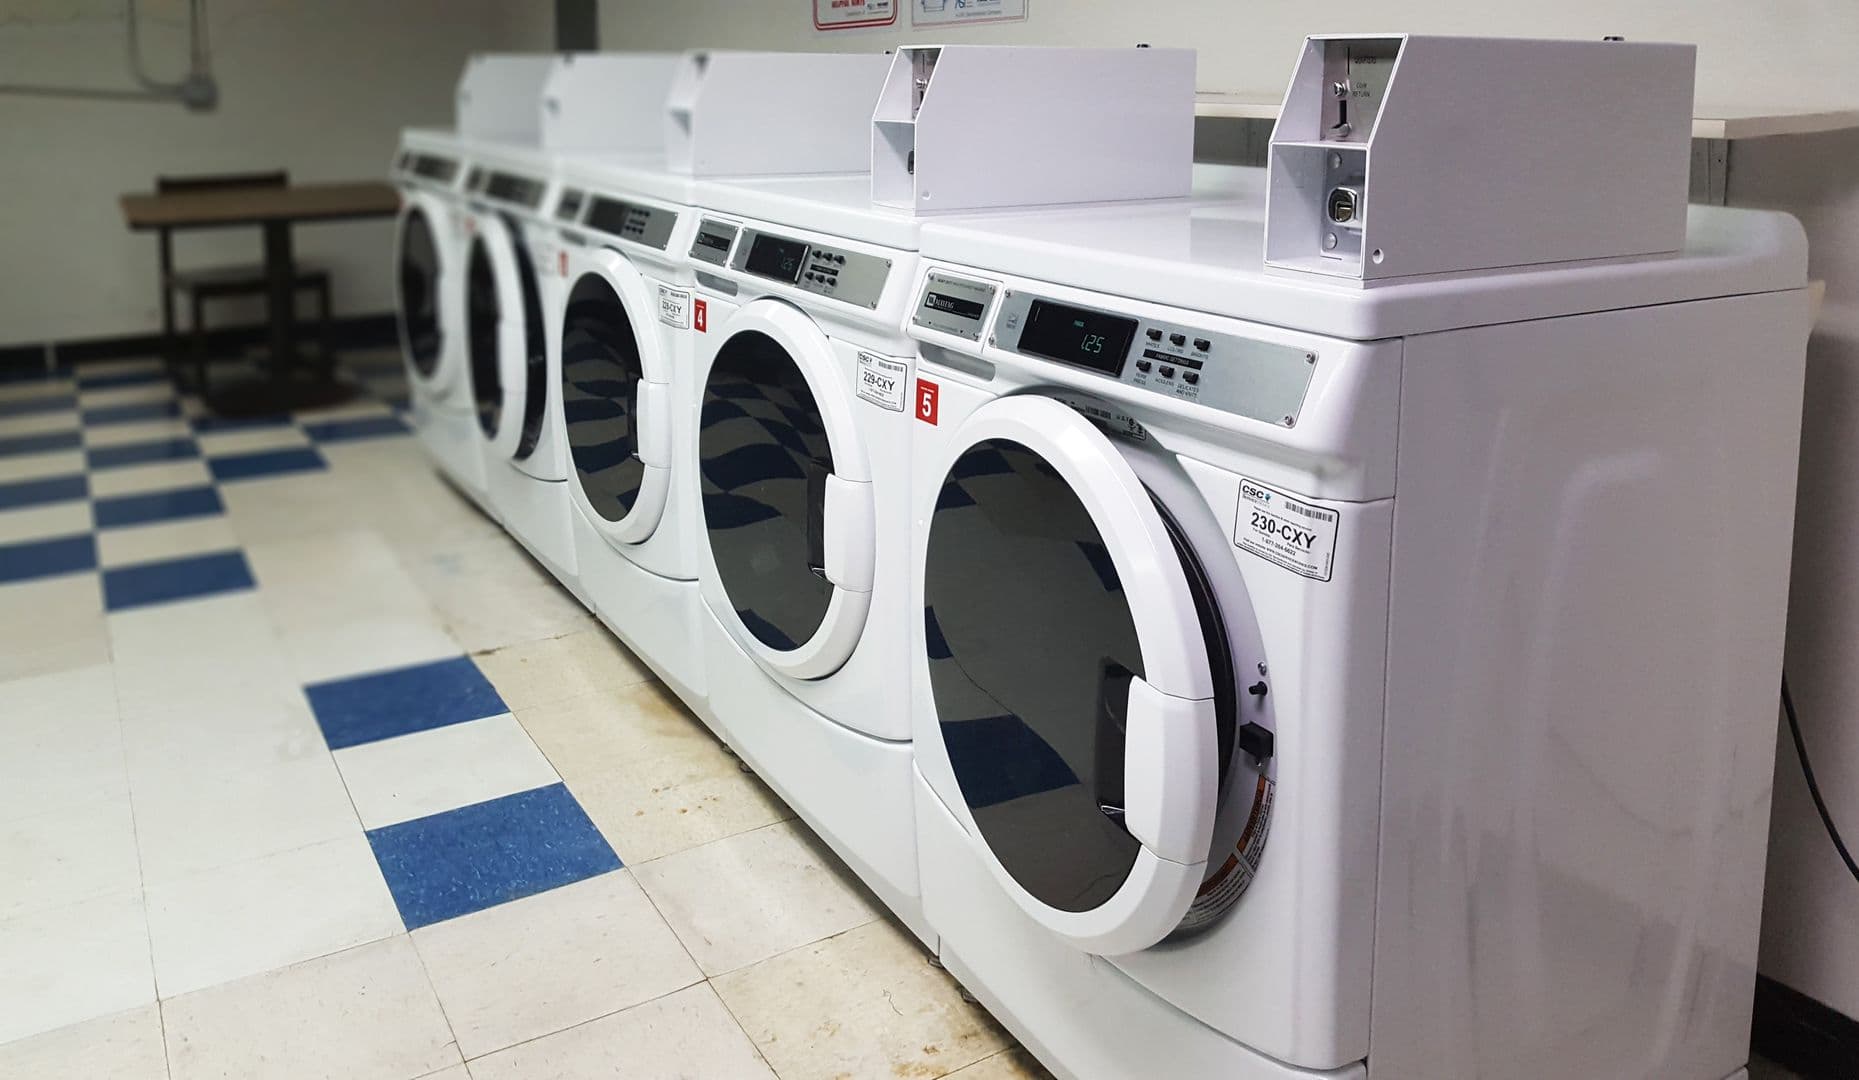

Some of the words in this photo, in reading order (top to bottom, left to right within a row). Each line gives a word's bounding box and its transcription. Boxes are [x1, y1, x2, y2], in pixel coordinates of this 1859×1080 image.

[697, 309, 704, 328] 4
[863, 371, 895, 391] 229-CXY
[922, 392, 933, 417] 5
[1242, 485, 1264, 499] CSC
[1251, 512, 1317, 549] 230-CXY
